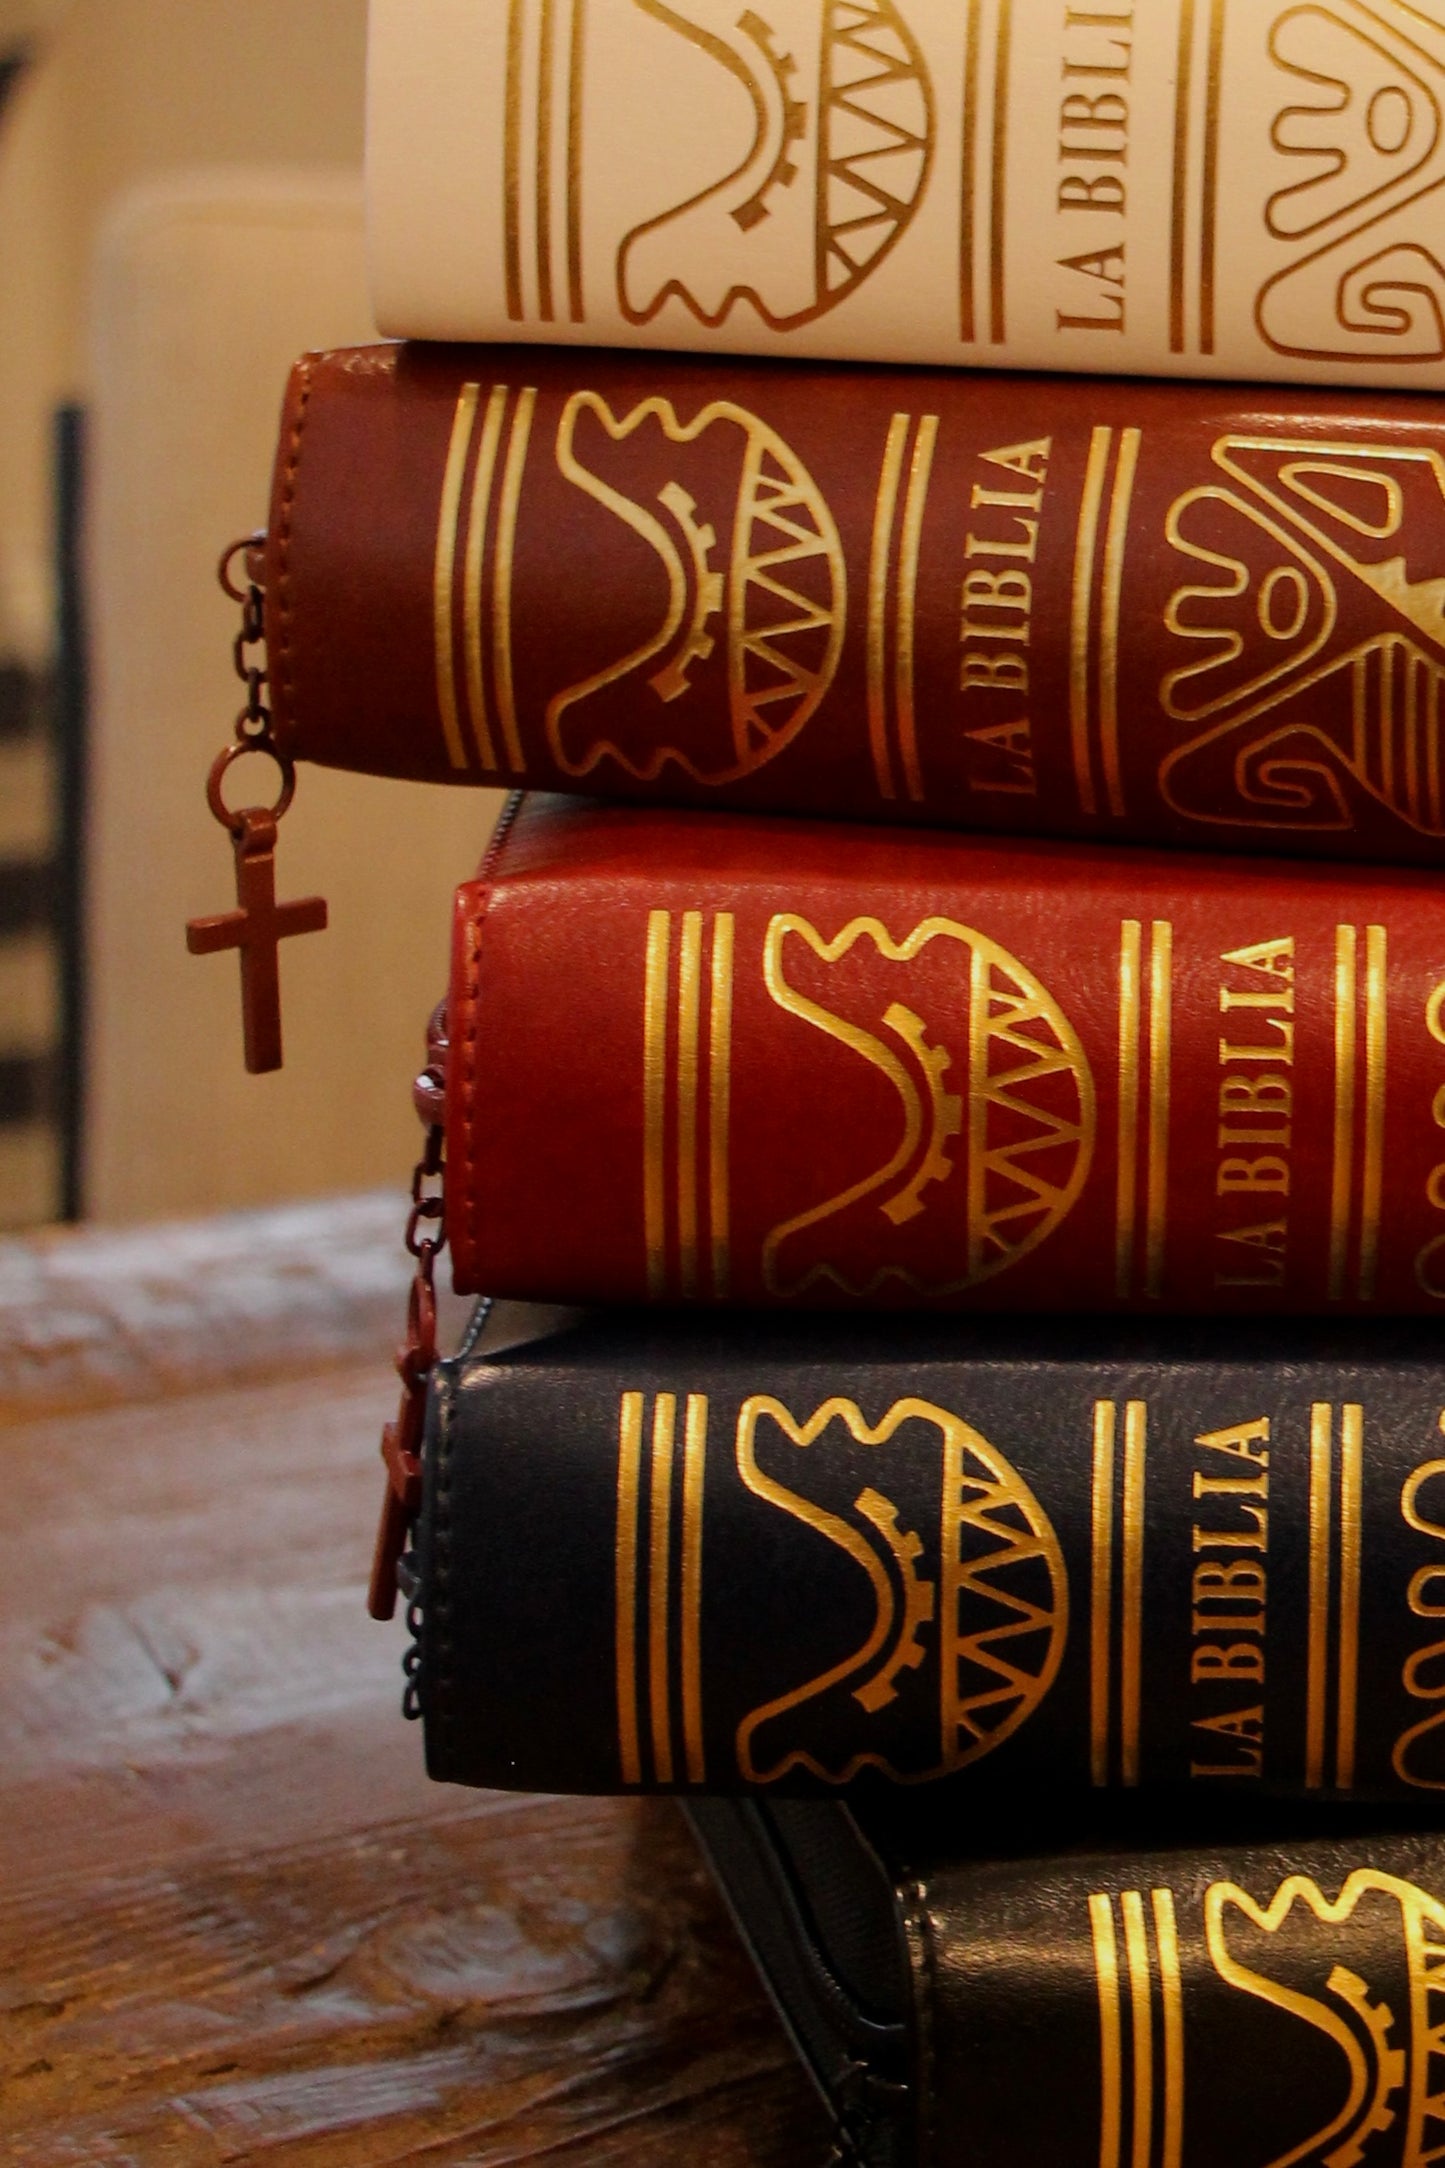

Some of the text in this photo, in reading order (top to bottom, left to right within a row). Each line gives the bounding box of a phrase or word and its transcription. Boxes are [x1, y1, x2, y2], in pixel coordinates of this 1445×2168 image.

[1053, 0, 1134, 336] LA BIBLI
[960, 436, 1053, 796] LA BIBLIA
[1214, 935, 1295, 1290] LA BIBLIA
[1190, 1416, 1270, 1778] LA BIBLIA
